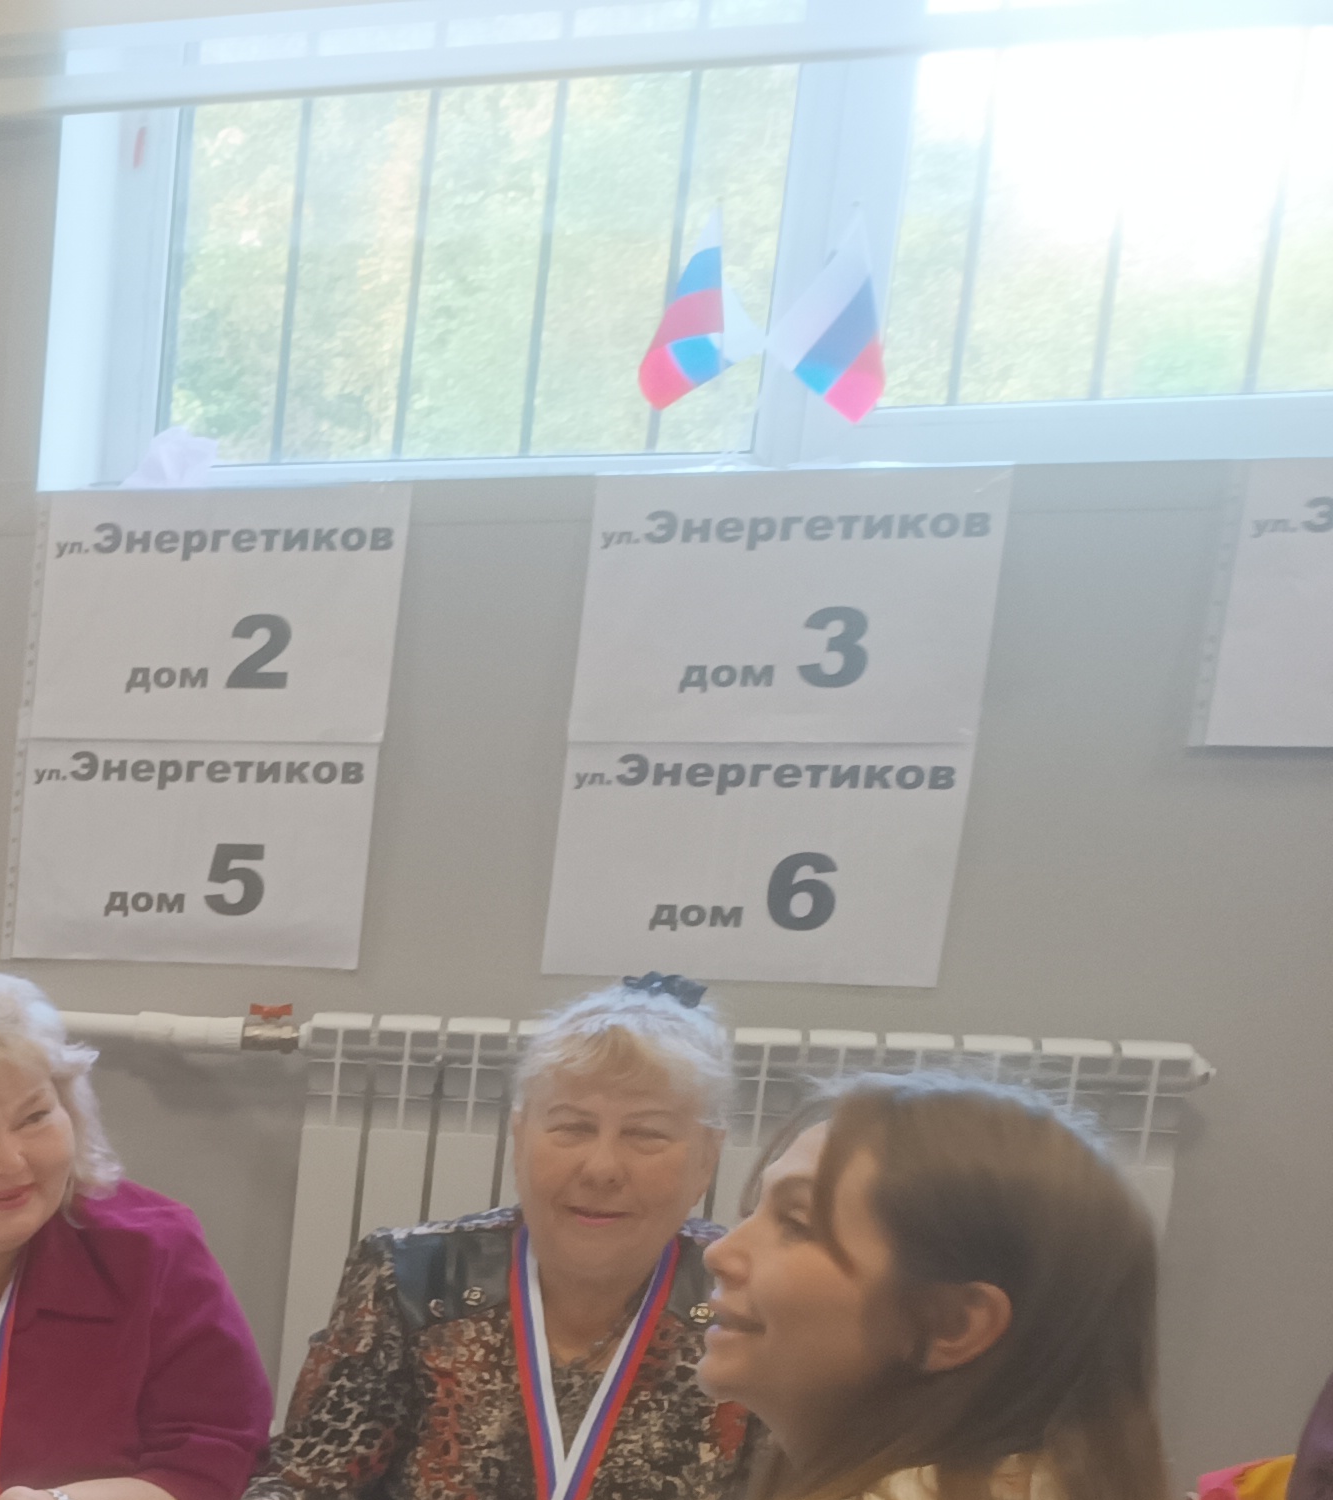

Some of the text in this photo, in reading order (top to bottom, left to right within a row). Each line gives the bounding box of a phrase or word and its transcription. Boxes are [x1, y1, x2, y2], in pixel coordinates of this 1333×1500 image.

[124, 613, 293, 694] дом 2
[677, 605, 869, 694] дом 3
[103, 842, 266, 919] дом 5
[647, 850, 838, 933] дом 6
